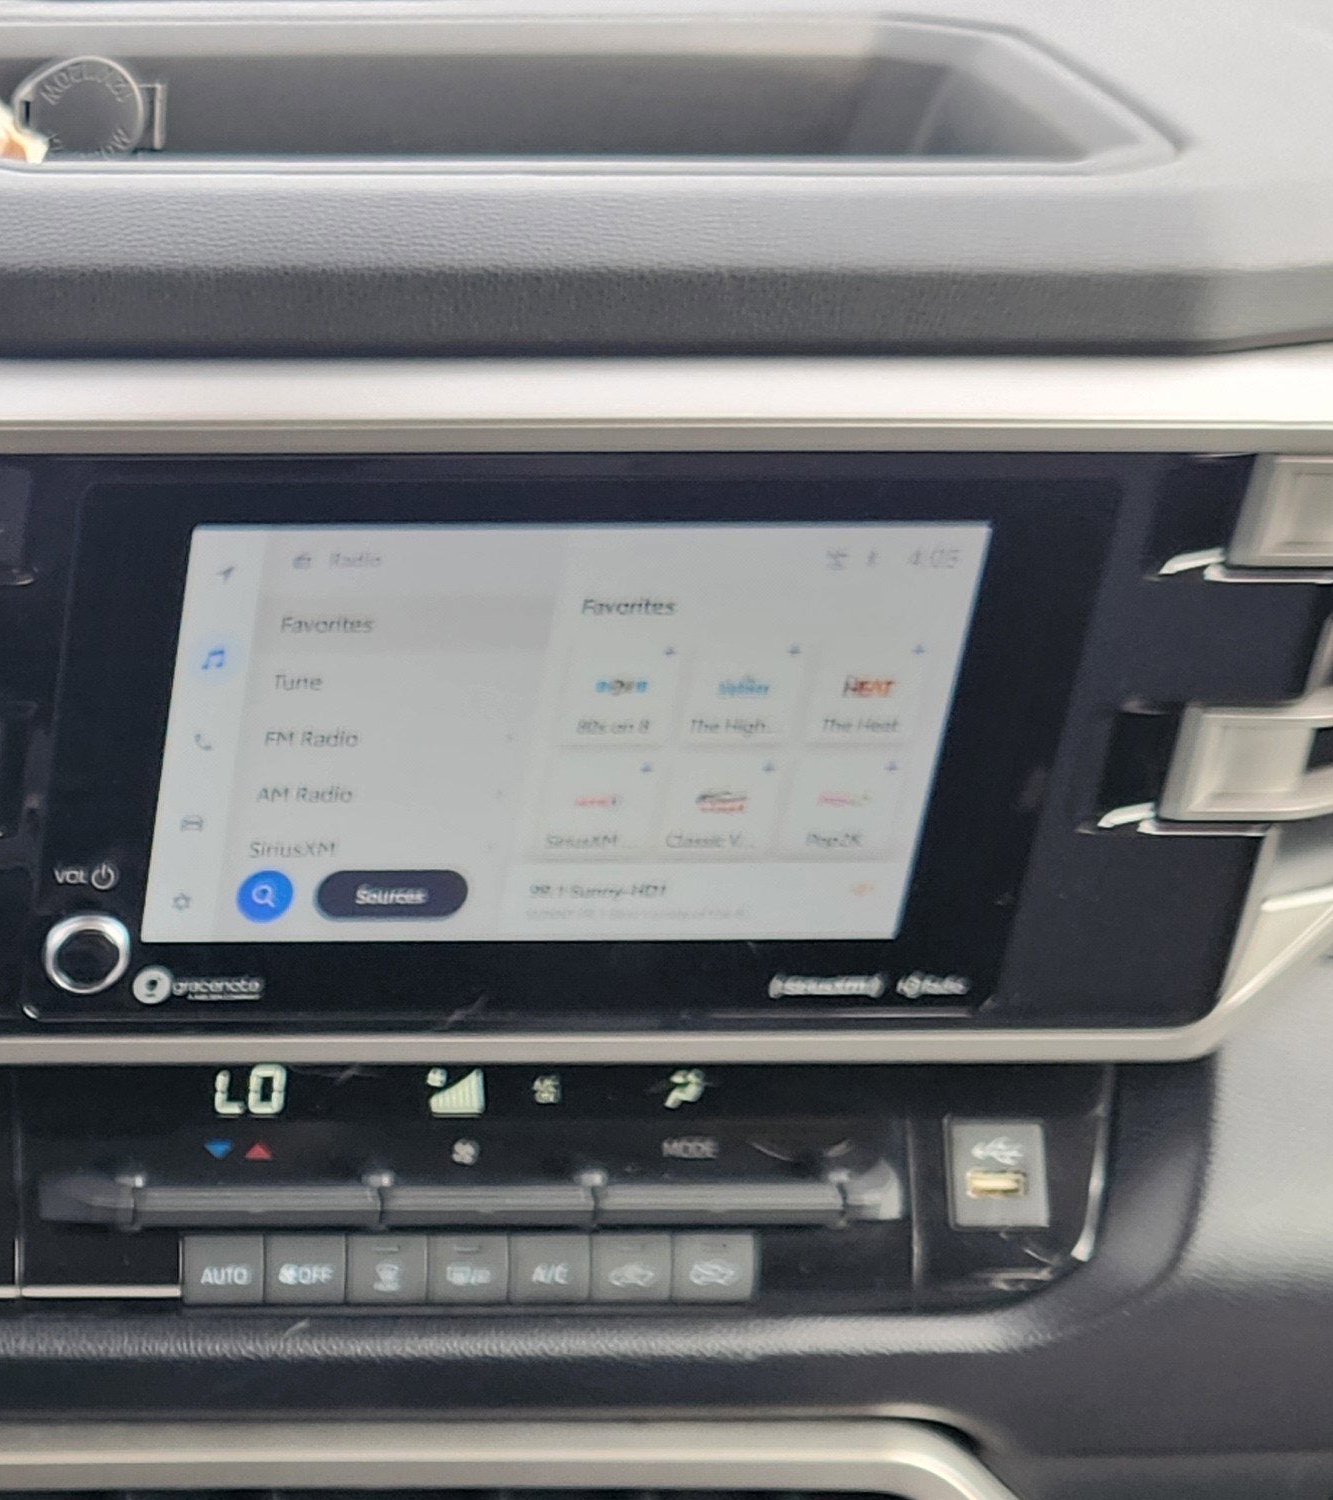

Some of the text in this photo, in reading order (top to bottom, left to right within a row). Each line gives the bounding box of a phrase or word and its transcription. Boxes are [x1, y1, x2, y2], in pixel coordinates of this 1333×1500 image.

[580, 597, 678, 616] Favorites
[280, 615, 375, 634] Favorites
[273, 673, 323, 692] Tune
[263, 730, 360, 749] FM Radio
[254, 785, 354, 805] AM Radio
[248, 840, 338, 859] SiriusXM
[53, 867, 89, 885] VOL
[354, 885, 429, 906] Sources
[199, 1264, 253, 1285] AUTO
[298, 1264, 334, 1285] OFF
[532, 1262, 569, 1285] A/C
